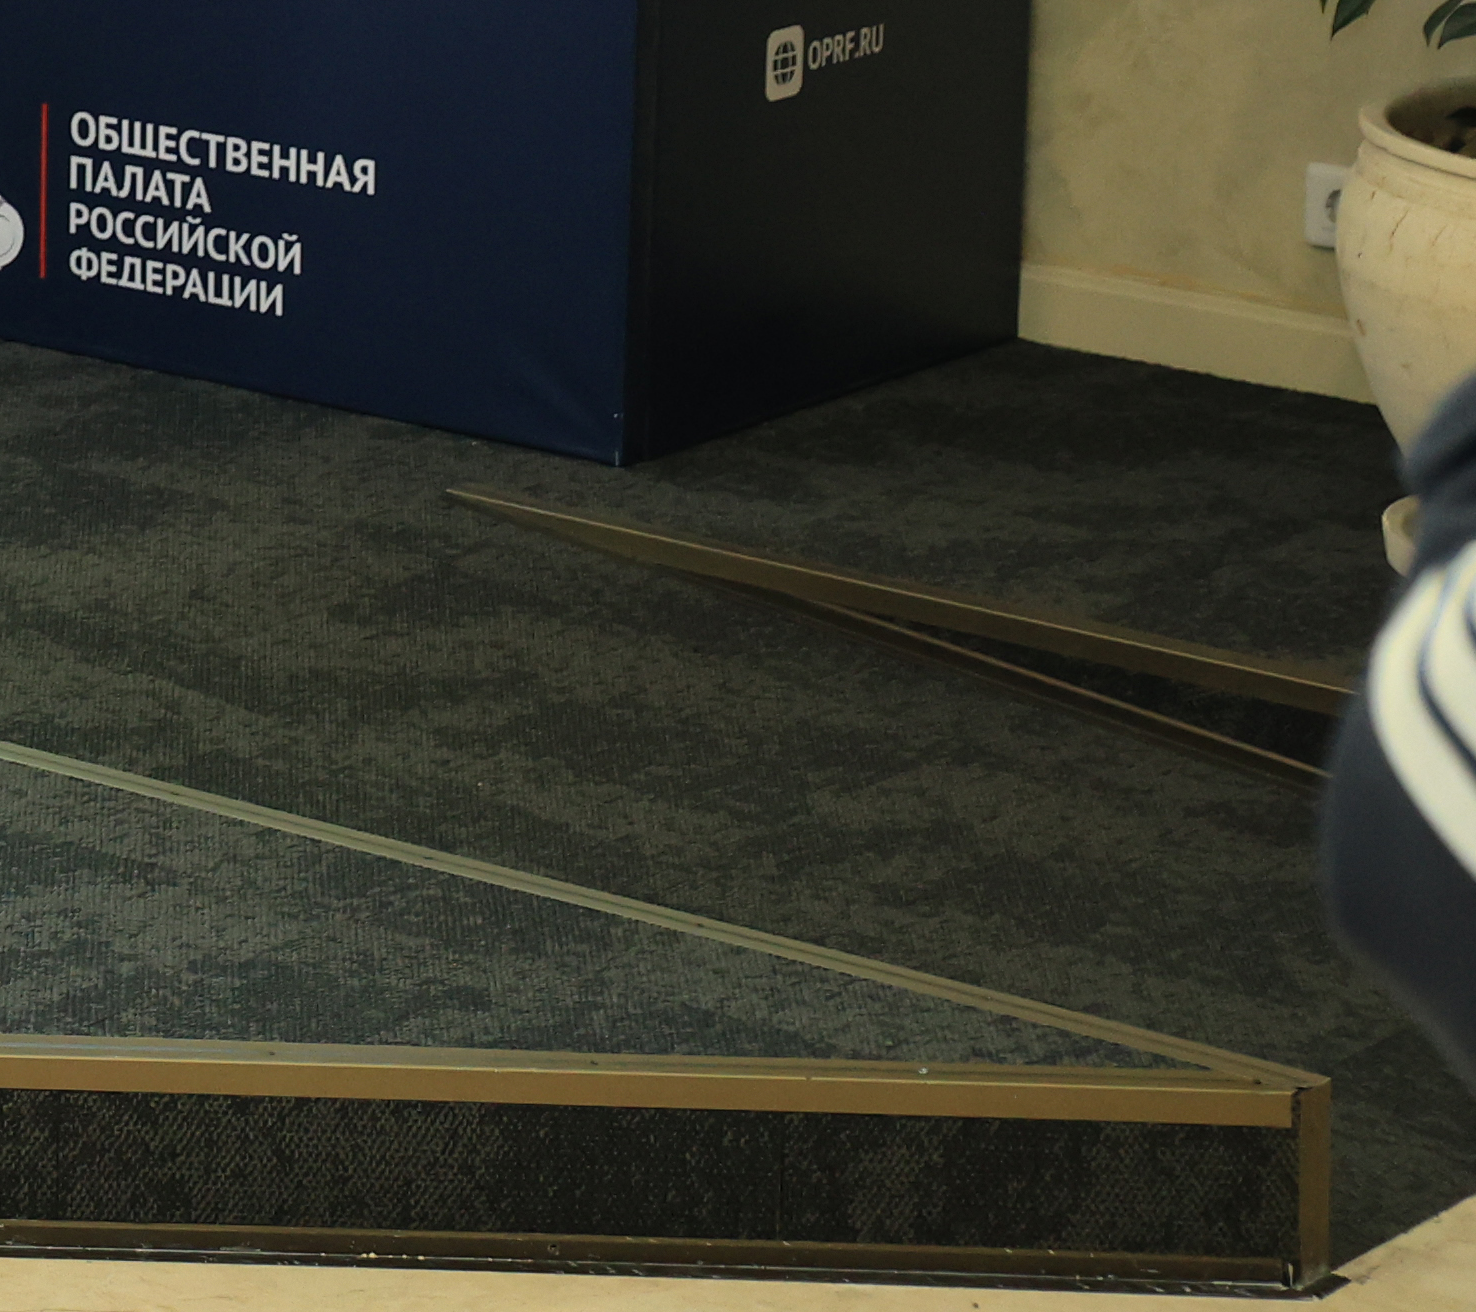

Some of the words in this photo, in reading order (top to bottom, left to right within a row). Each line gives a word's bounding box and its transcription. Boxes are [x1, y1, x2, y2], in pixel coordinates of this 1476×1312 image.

[807, 23, 885, 73] OPRF.RU
[67, 155, 213, 215] ПАЛАТА
[68, 109, 377, 197] ОБЩЕСТВЕННАЯ
[67, 199, 303, 278] РОССИЙСКОЙ
[67, 245, 284, 318] ФЕДЕРАЦИИ
